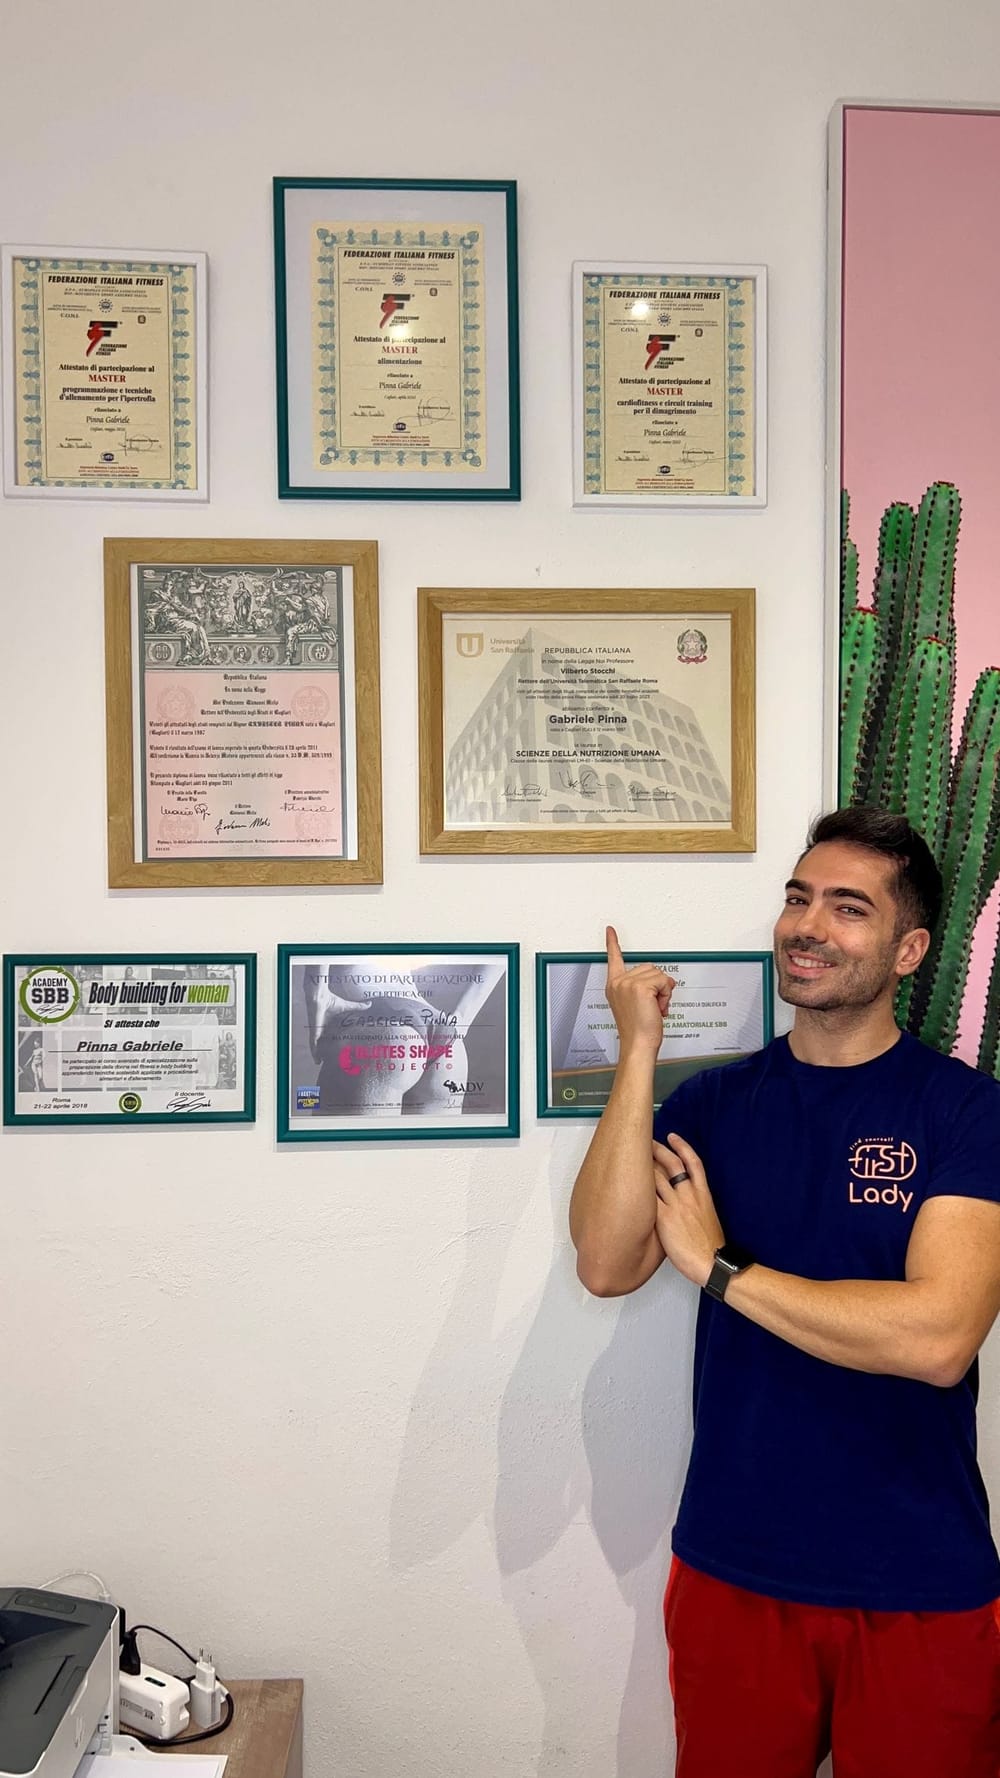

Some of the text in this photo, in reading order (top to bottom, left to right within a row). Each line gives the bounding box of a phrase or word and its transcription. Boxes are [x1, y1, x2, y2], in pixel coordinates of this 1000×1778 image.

[343, 250, 391, 258] FEDERAZIONE
[394, 251, 426, 259] ITALIANA
[48, 276, 164, 286] FEDERAZIONE ITALIANA FITNESS
[608, 290, 720, 300] FEDERAZIONE ITALIANA FITNESS
[382, 346, 418, 354] MASTER
[58, 364, 88, 372] Attestato
[90, 364, 97, 372] di
[98, 364, 146, 373] partecipazione
[88, 374, 126, 383] MASTER
[398, 382, 422, 390] Gabriele
[647, 387, 684, 396] MASTER
[86, 416, 130, 424] Pinna Gabriele
[662, 428, 686, 436] Gabriele
[549, 715, 628, 724] Gabriele Pinna
[32, 978, 68, 987] ACADEMY
[308, 974, 484, 985] ATTESTATO DI PARTECIPAZIONE
[31, 988, 69, 1004] SBB
[88, 982, 230, 1006] Body building for woman
[340, 1008, 458, 1028] GABRIELE PINNA
[104, 1020, 160, 1028] Si attesta che
[77, 1040, 184, 1052] Pinna Gabriele
[409, 1045, 453, 1058] SHAPE
[850, 1182, 914, 1213] Lady
